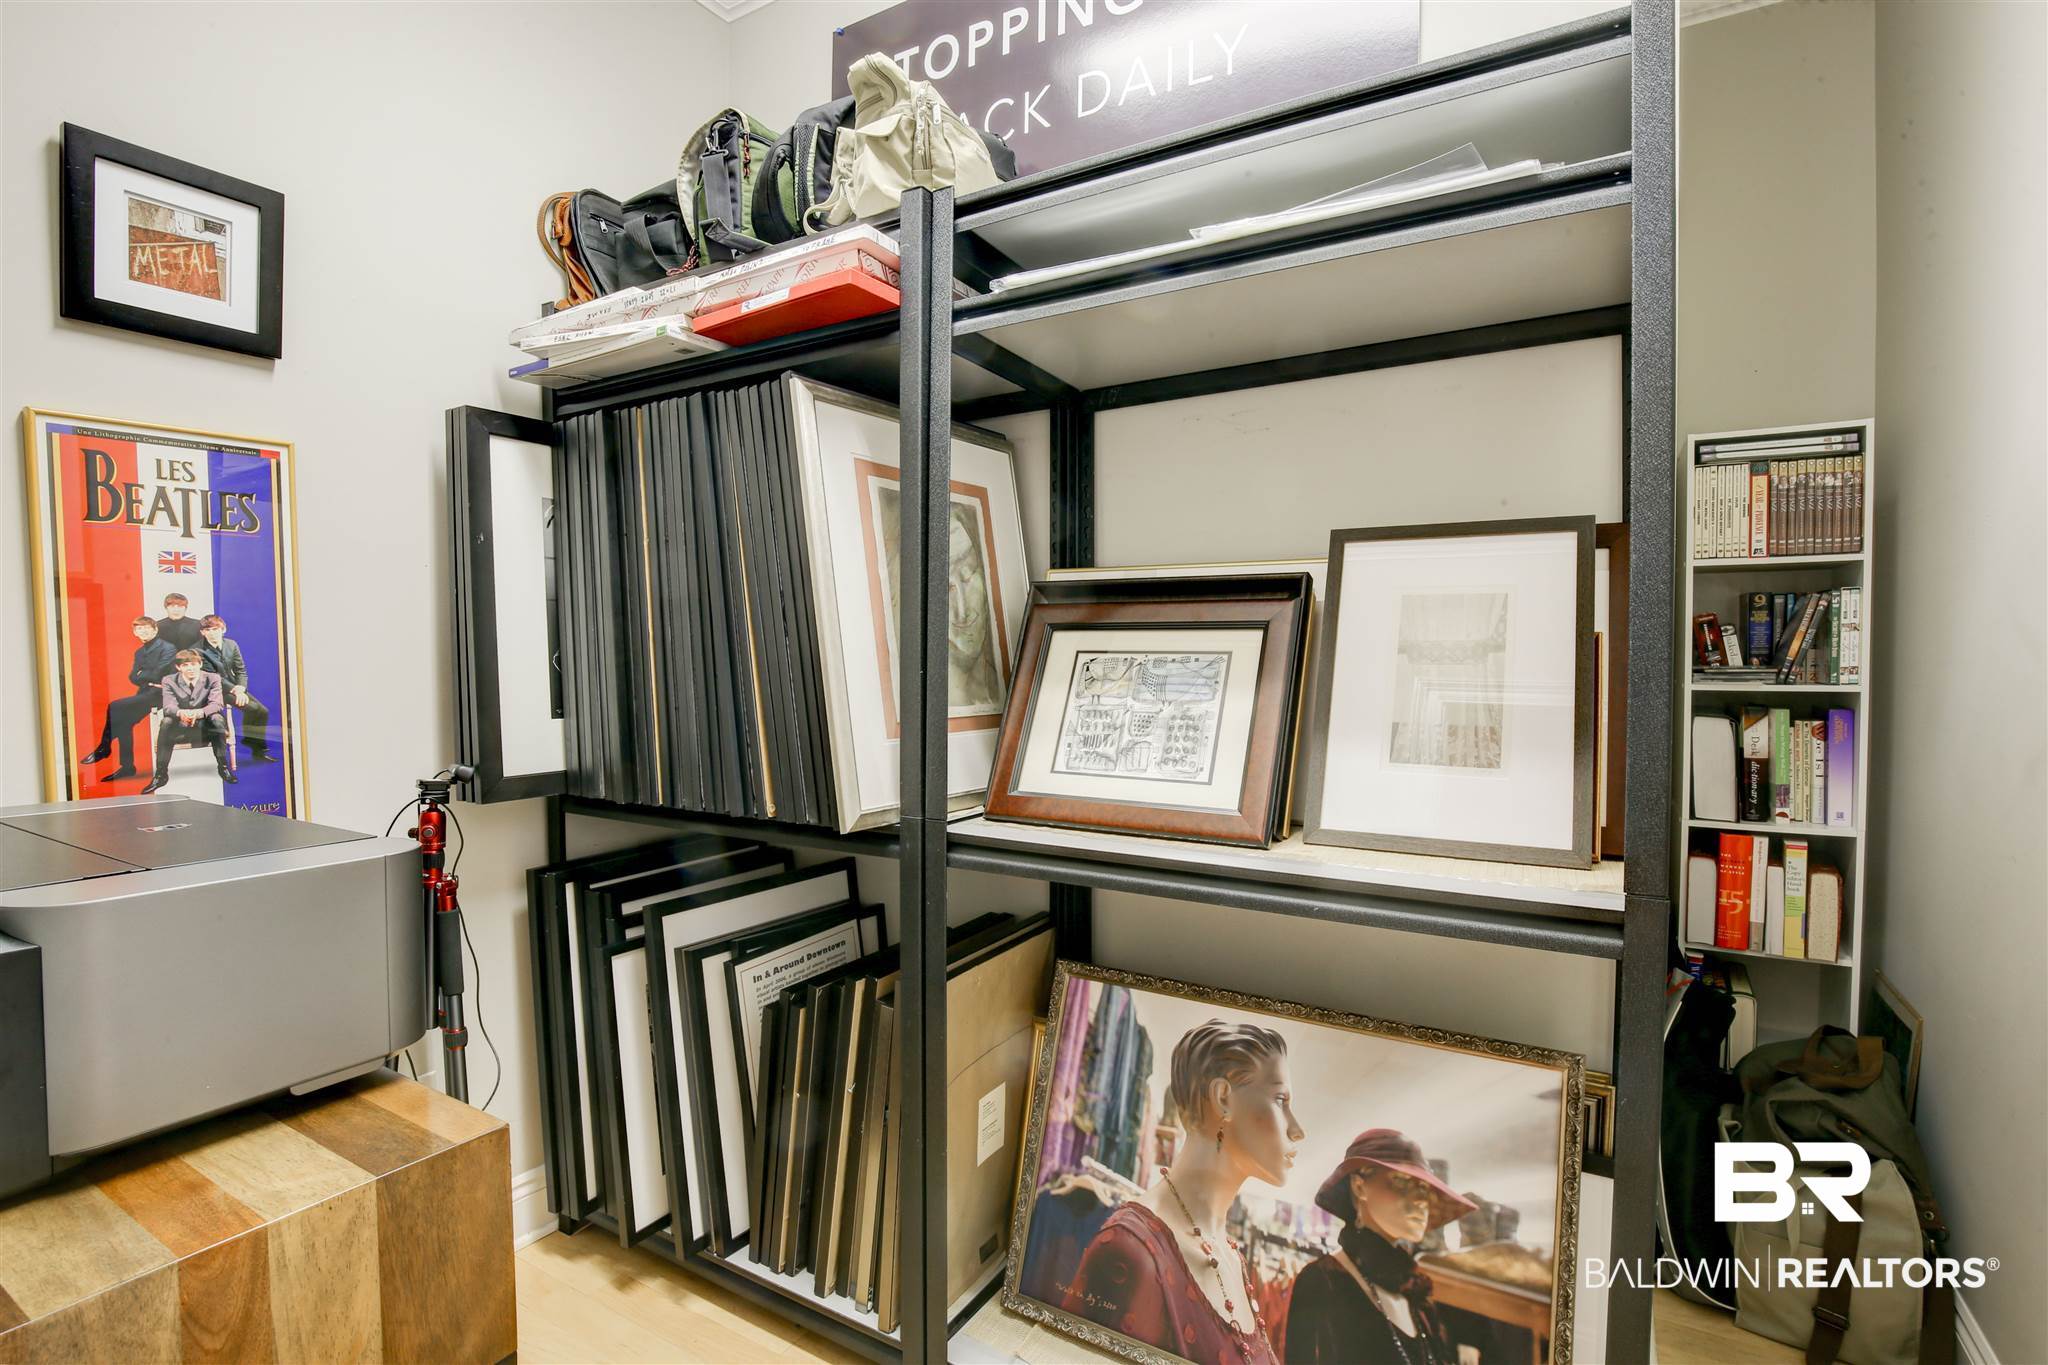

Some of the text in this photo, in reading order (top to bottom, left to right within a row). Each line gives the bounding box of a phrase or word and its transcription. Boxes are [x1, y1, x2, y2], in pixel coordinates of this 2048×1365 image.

[1077, 23, 1248, 118] DAILY
[134, 243, 218, 278] METAL
[155, 457, 196, 483] LES
[80, 448, 261, 538] BEATLES
[753, 940, 846, 983] In & Around Downtown
